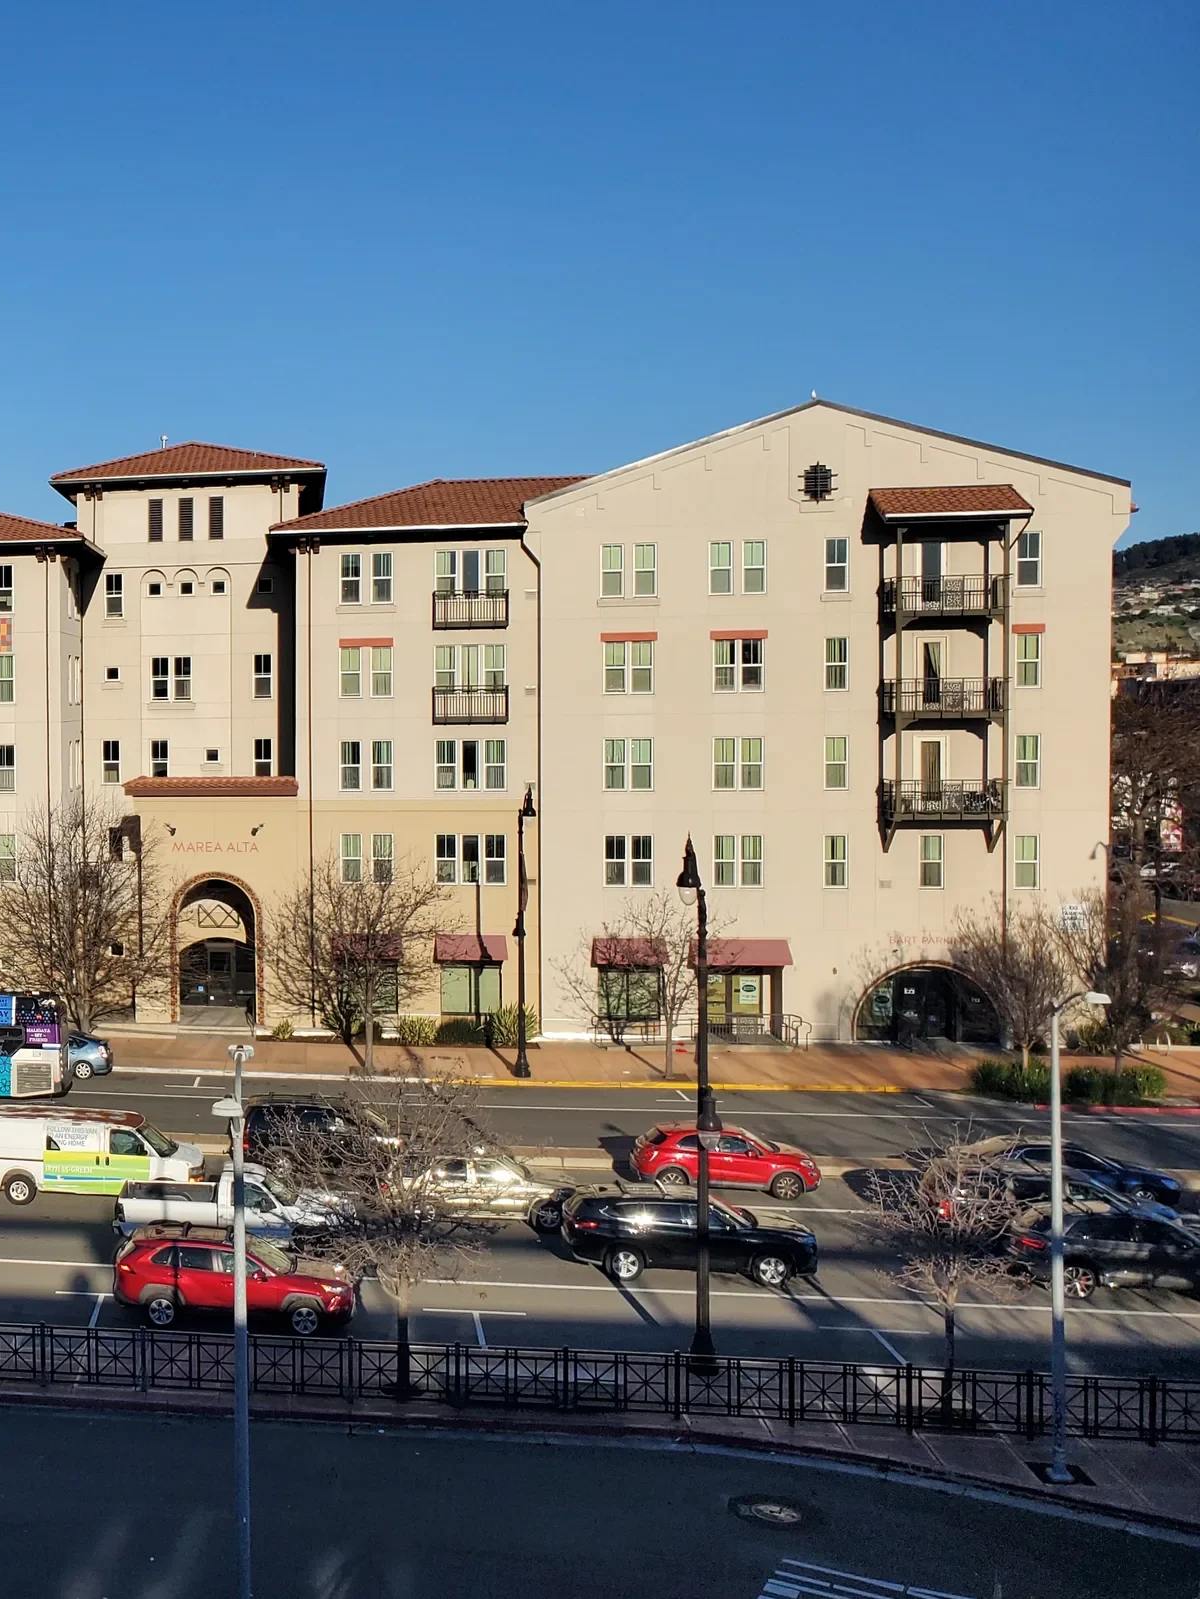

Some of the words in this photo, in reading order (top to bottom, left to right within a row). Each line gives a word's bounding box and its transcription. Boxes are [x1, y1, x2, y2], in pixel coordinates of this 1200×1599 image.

[171, 841, 223, 853] MAREA
[226, 841, 259, 853] ALTA
[889, 936, 916, 945] BART
[921, 936, 970, 946] PARKING
